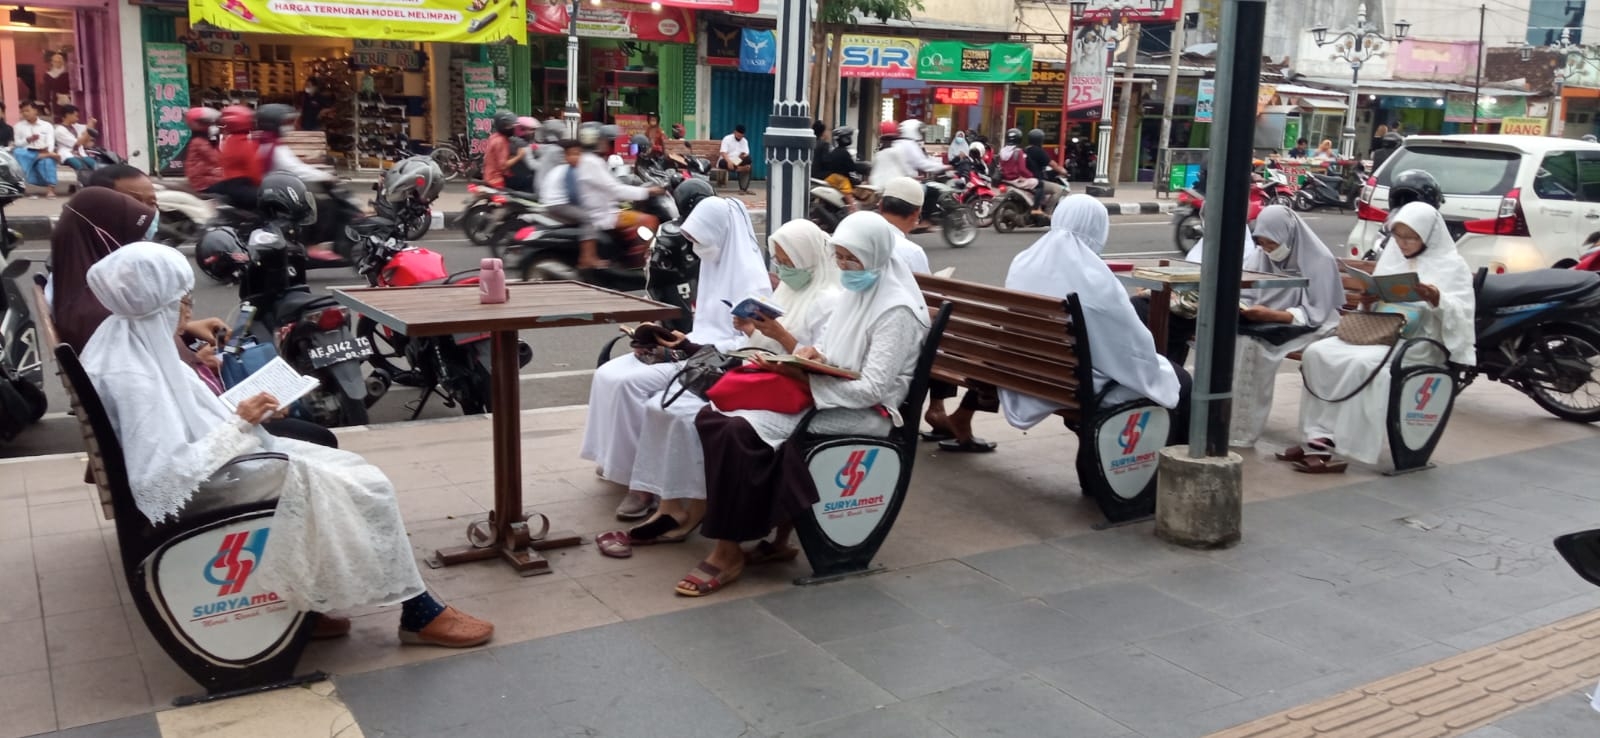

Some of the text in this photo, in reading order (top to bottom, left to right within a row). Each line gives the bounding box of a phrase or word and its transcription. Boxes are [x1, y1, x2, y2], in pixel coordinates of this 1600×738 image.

[274, 3, 457, 22] HARGA TERMURAH MODEL MELIMPAH
[1071, 75, 1103, 85] DISKON
[1503, 123, 1542, 136] UANG
[355, 336, 370, 348] TC
[824, 494, 884, 512] SURYAmart
[192, 591, 280, 618] SURYAma
